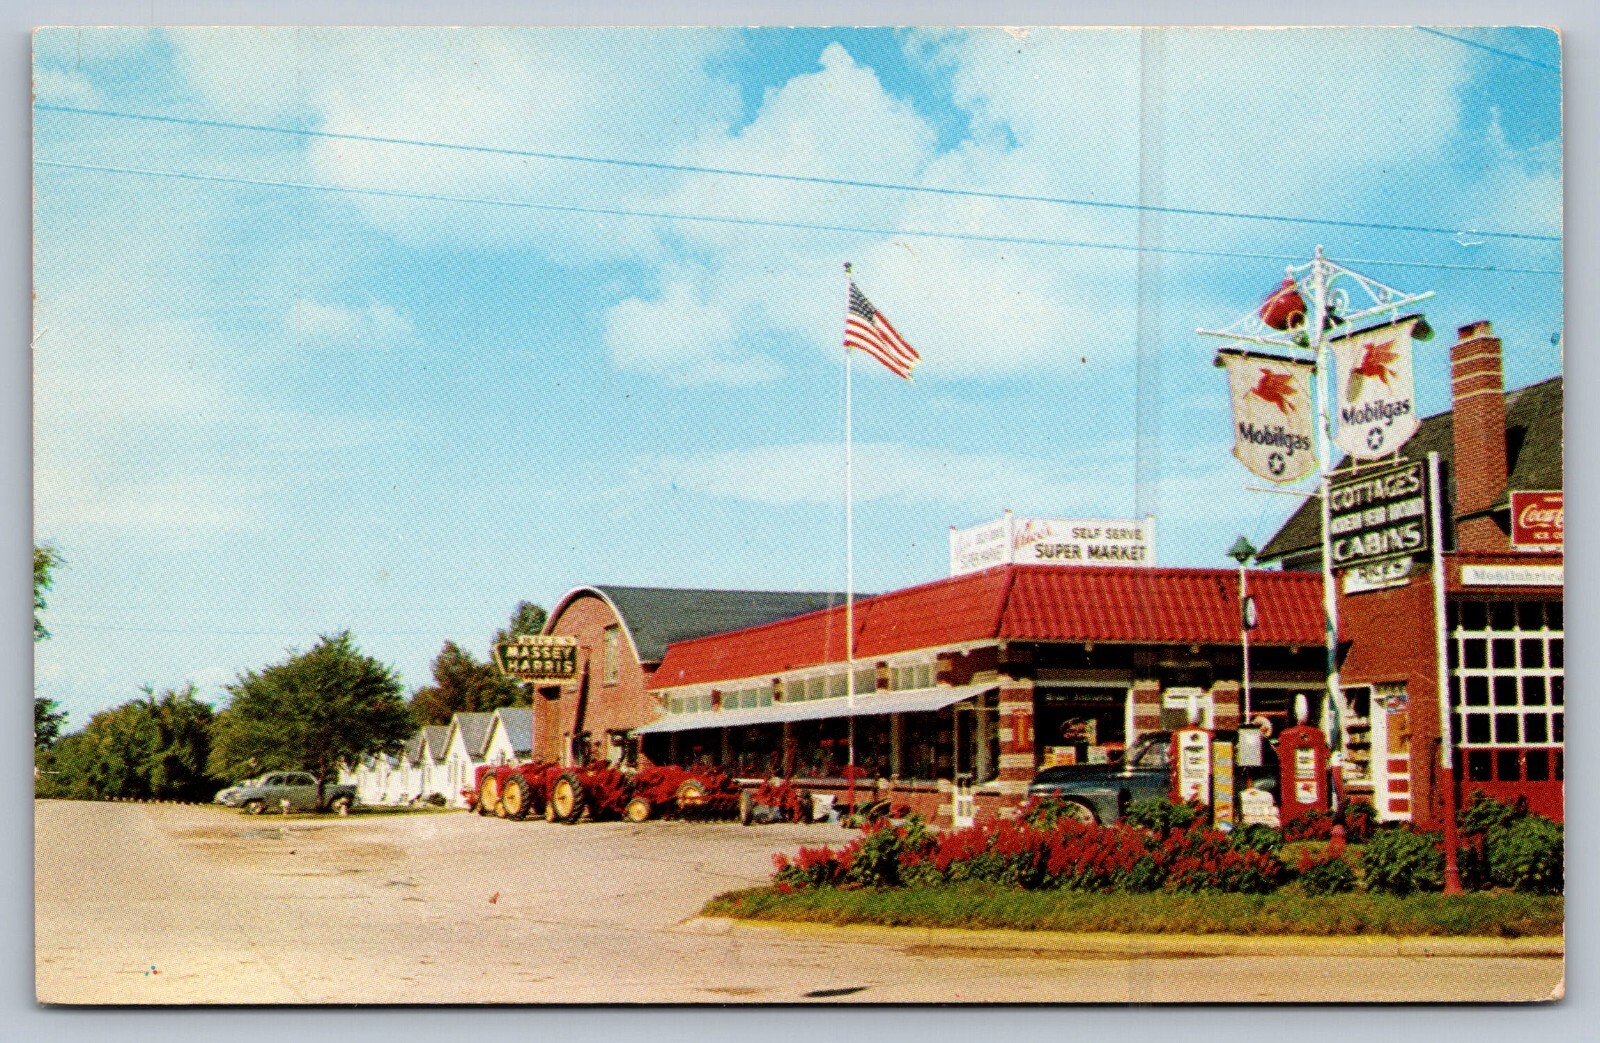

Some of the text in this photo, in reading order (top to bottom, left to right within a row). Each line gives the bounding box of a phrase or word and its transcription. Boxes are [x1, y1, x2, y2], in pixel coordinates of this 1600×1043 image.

[1342, 400, 1411, 426] Mobilgas
[1238, 421, 1311, 456] Mobilgas
[1331, 467, 1421, 511] COTTAGES
[1071, 527, 1144, 540] SELF SERVE
[1333, 522, 1422, 560] CABINS
[1034, 543, 1148, 561] SUPER MARKET
[506, 646, 574, 658] MASSEY
[508, 659, 575, 673] HARRIS
